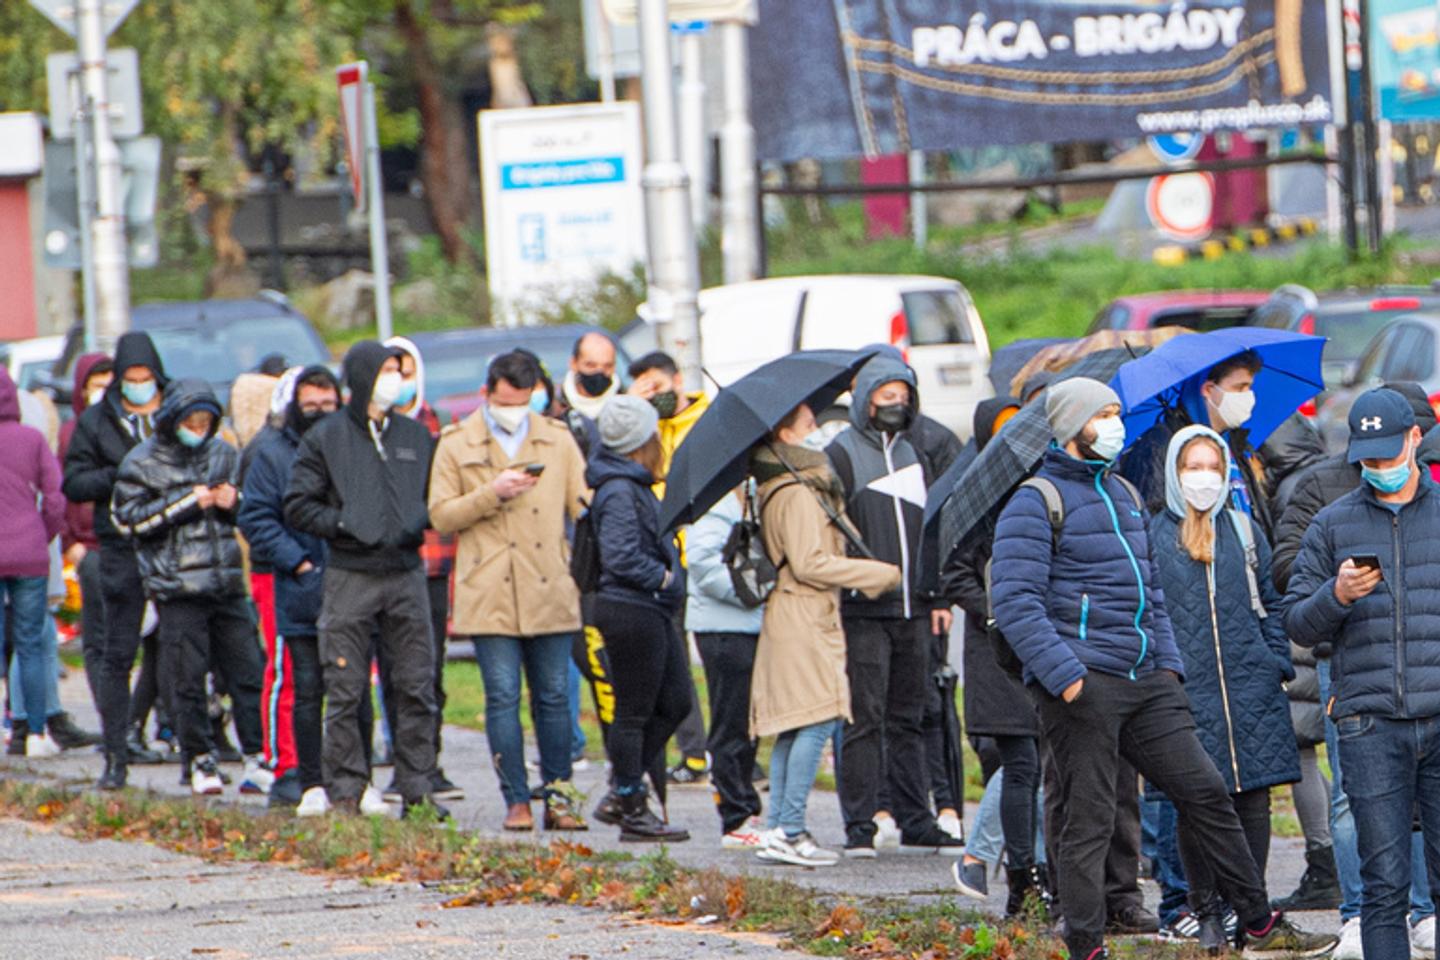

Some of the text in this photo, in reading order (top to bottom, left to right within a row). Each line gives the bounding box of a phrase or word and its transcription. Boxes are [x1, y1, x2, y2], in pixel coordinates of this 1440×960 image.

[912, 1, 1245, 67] PRÁCA - BRIGÁDY
